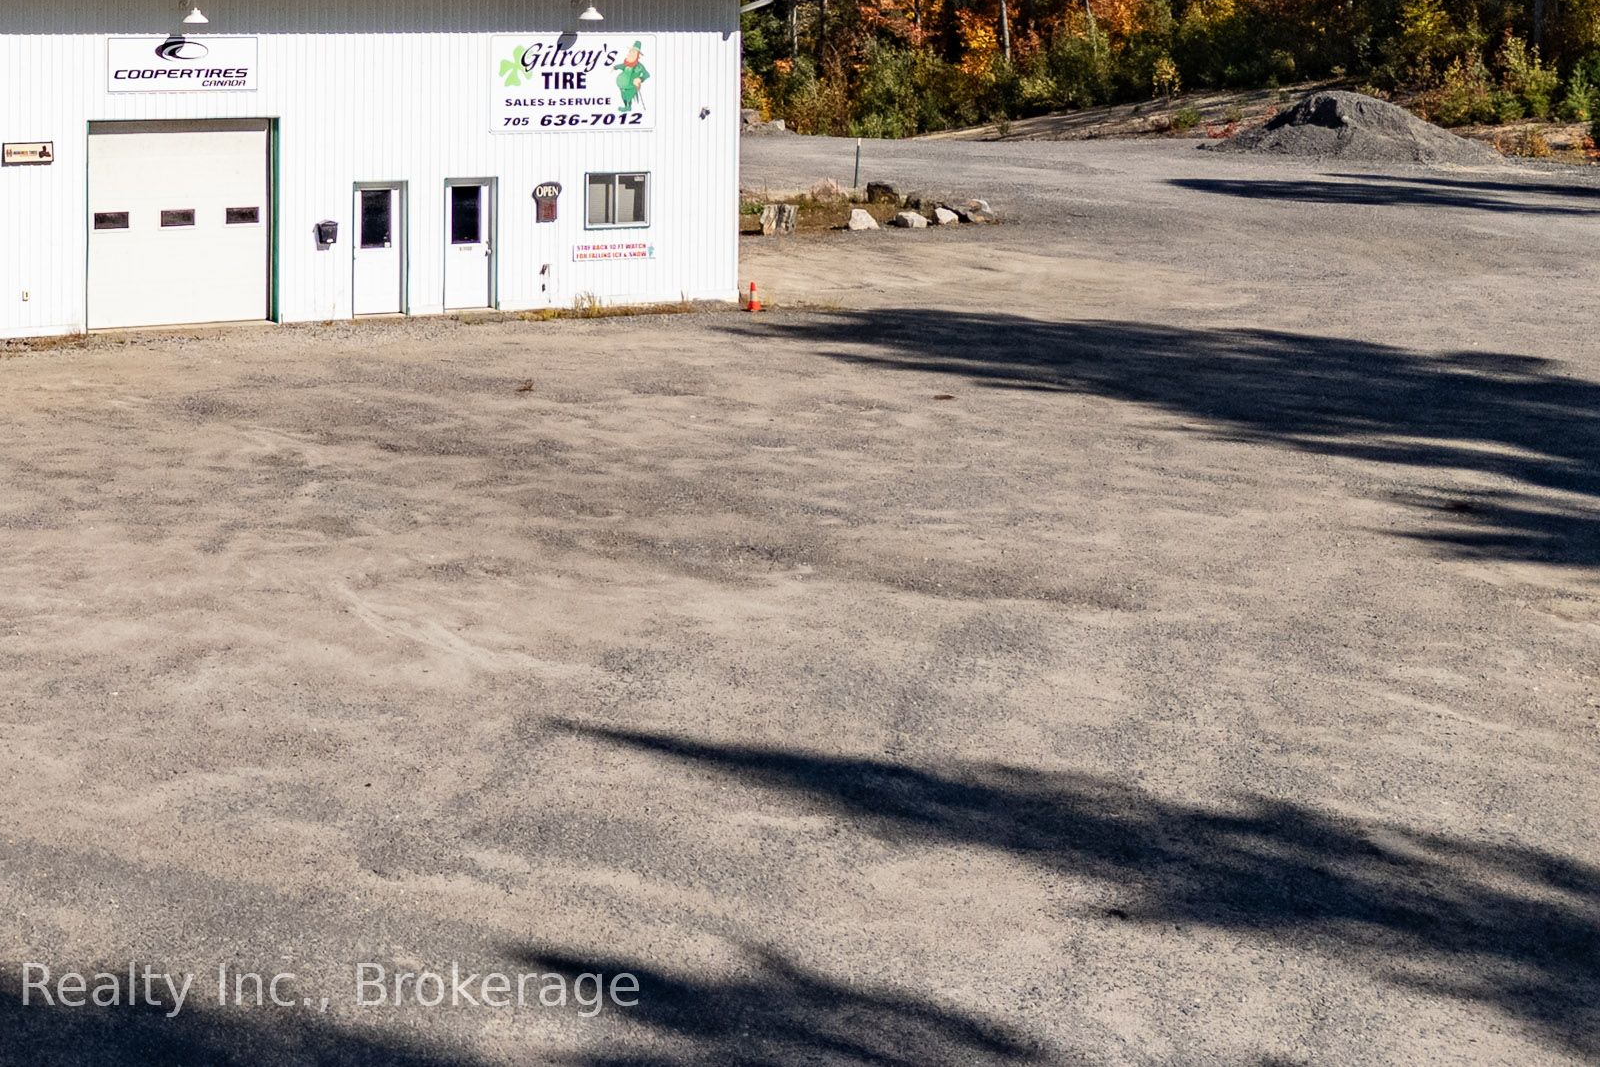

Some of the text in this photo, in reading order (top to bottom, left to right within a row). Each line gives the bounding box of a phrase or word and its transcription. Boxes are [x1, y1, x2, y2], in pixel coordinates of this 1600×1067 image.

[520, 42, 618, 72] Gilroy's
[541, 72, 587, 90] TIRE
[505, 98, 545, 107] SALES
[559, 97, 612, 106] SERVICE
[503, 112, 643, 127] 705 636-7012
[536, 185, 559, 197] OPEN
